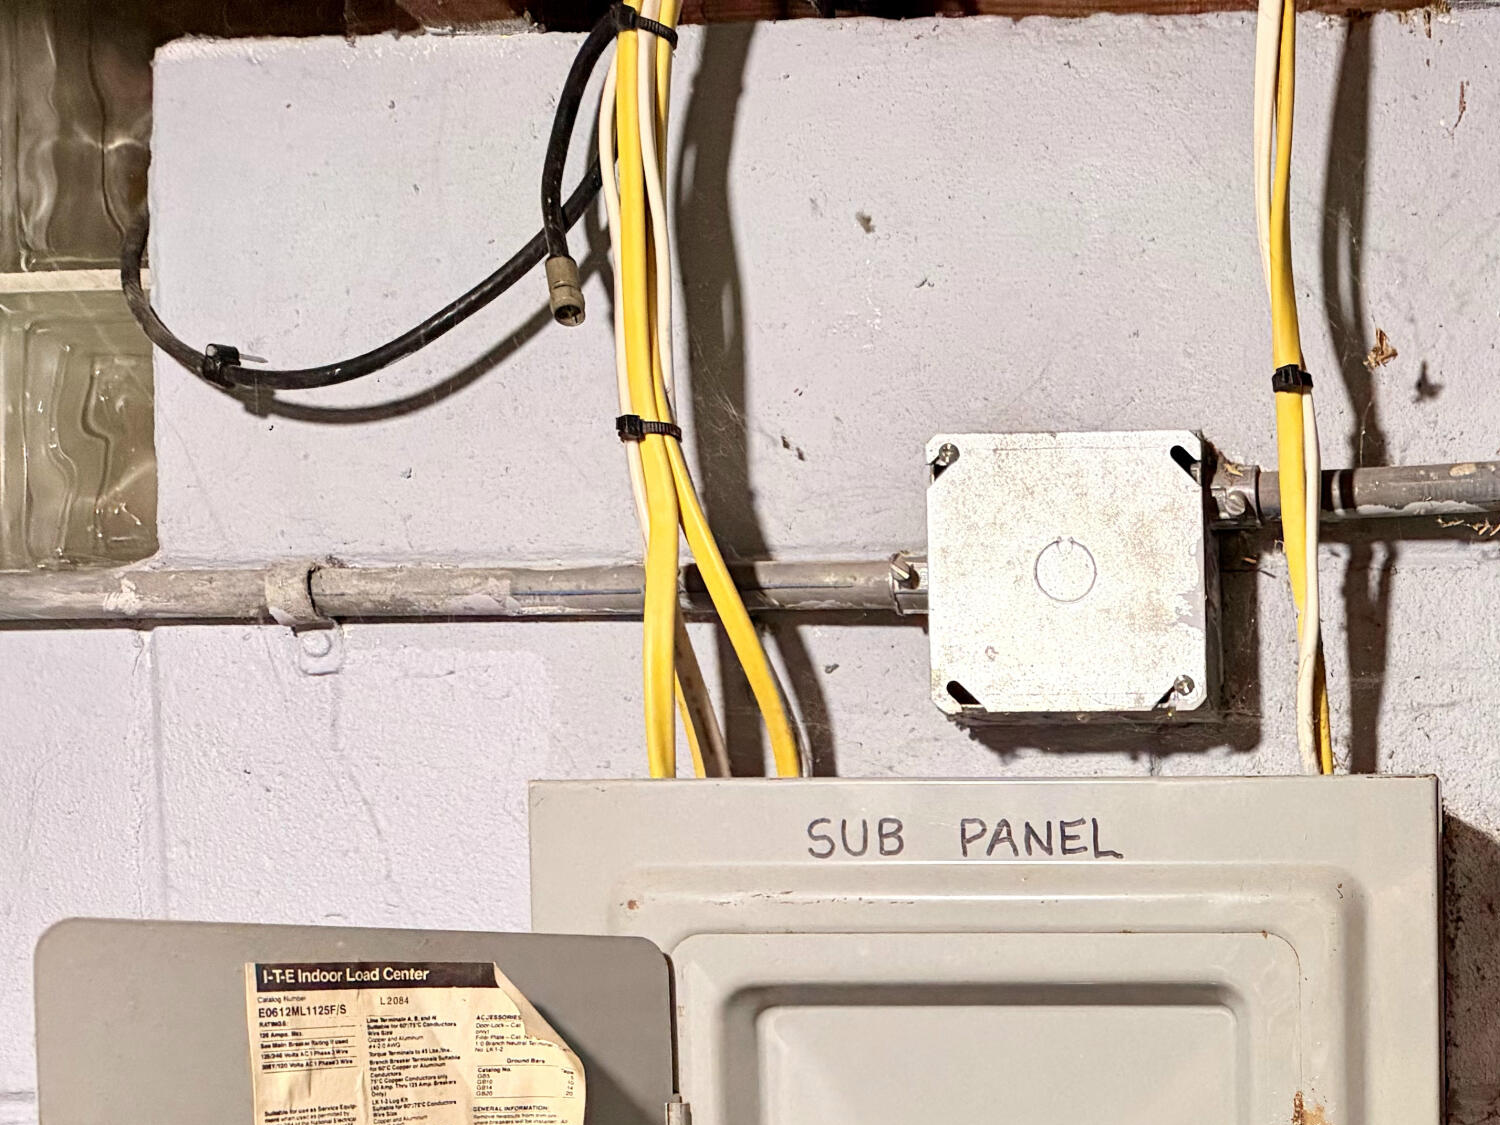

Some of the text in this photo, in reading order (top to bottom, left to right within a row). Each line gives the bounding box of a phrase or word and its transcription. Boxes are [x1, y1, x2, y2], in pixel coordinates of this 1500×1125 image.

[808, 818, 1124, 859] SUB PANEL
[263, 967, 429, 983] I-T-E Indoor Load Center
